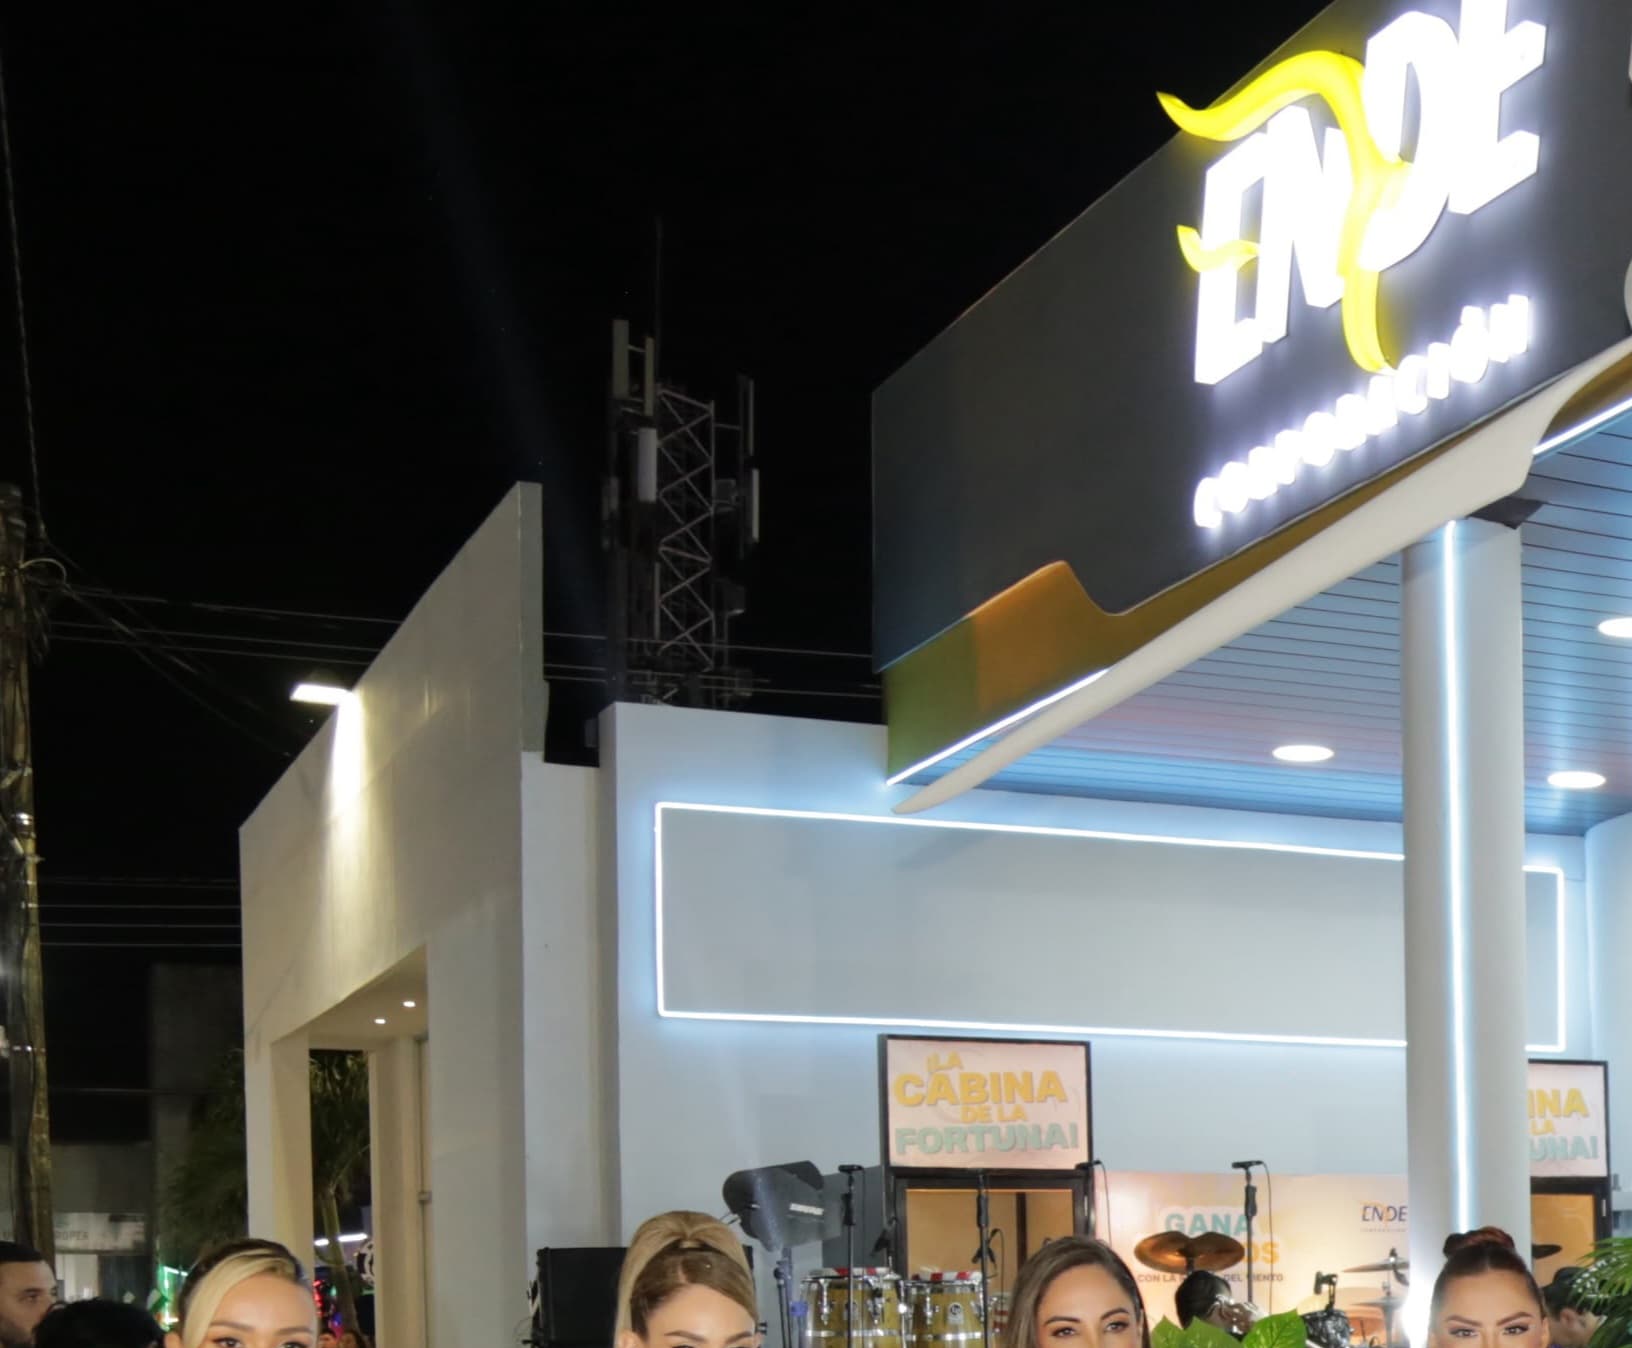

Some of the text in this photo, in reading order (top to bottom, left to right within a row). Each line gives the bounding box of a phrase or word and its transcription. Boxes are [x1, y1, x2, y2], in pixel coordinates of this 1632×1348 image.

[894, 1070, 1068, 1107] CABINA
[960, 1103, 1028, 1123] DE LA
[1362, 1205, 1409, 1222] ENDE
[1165, 1213, 1250, 1236] GANA
